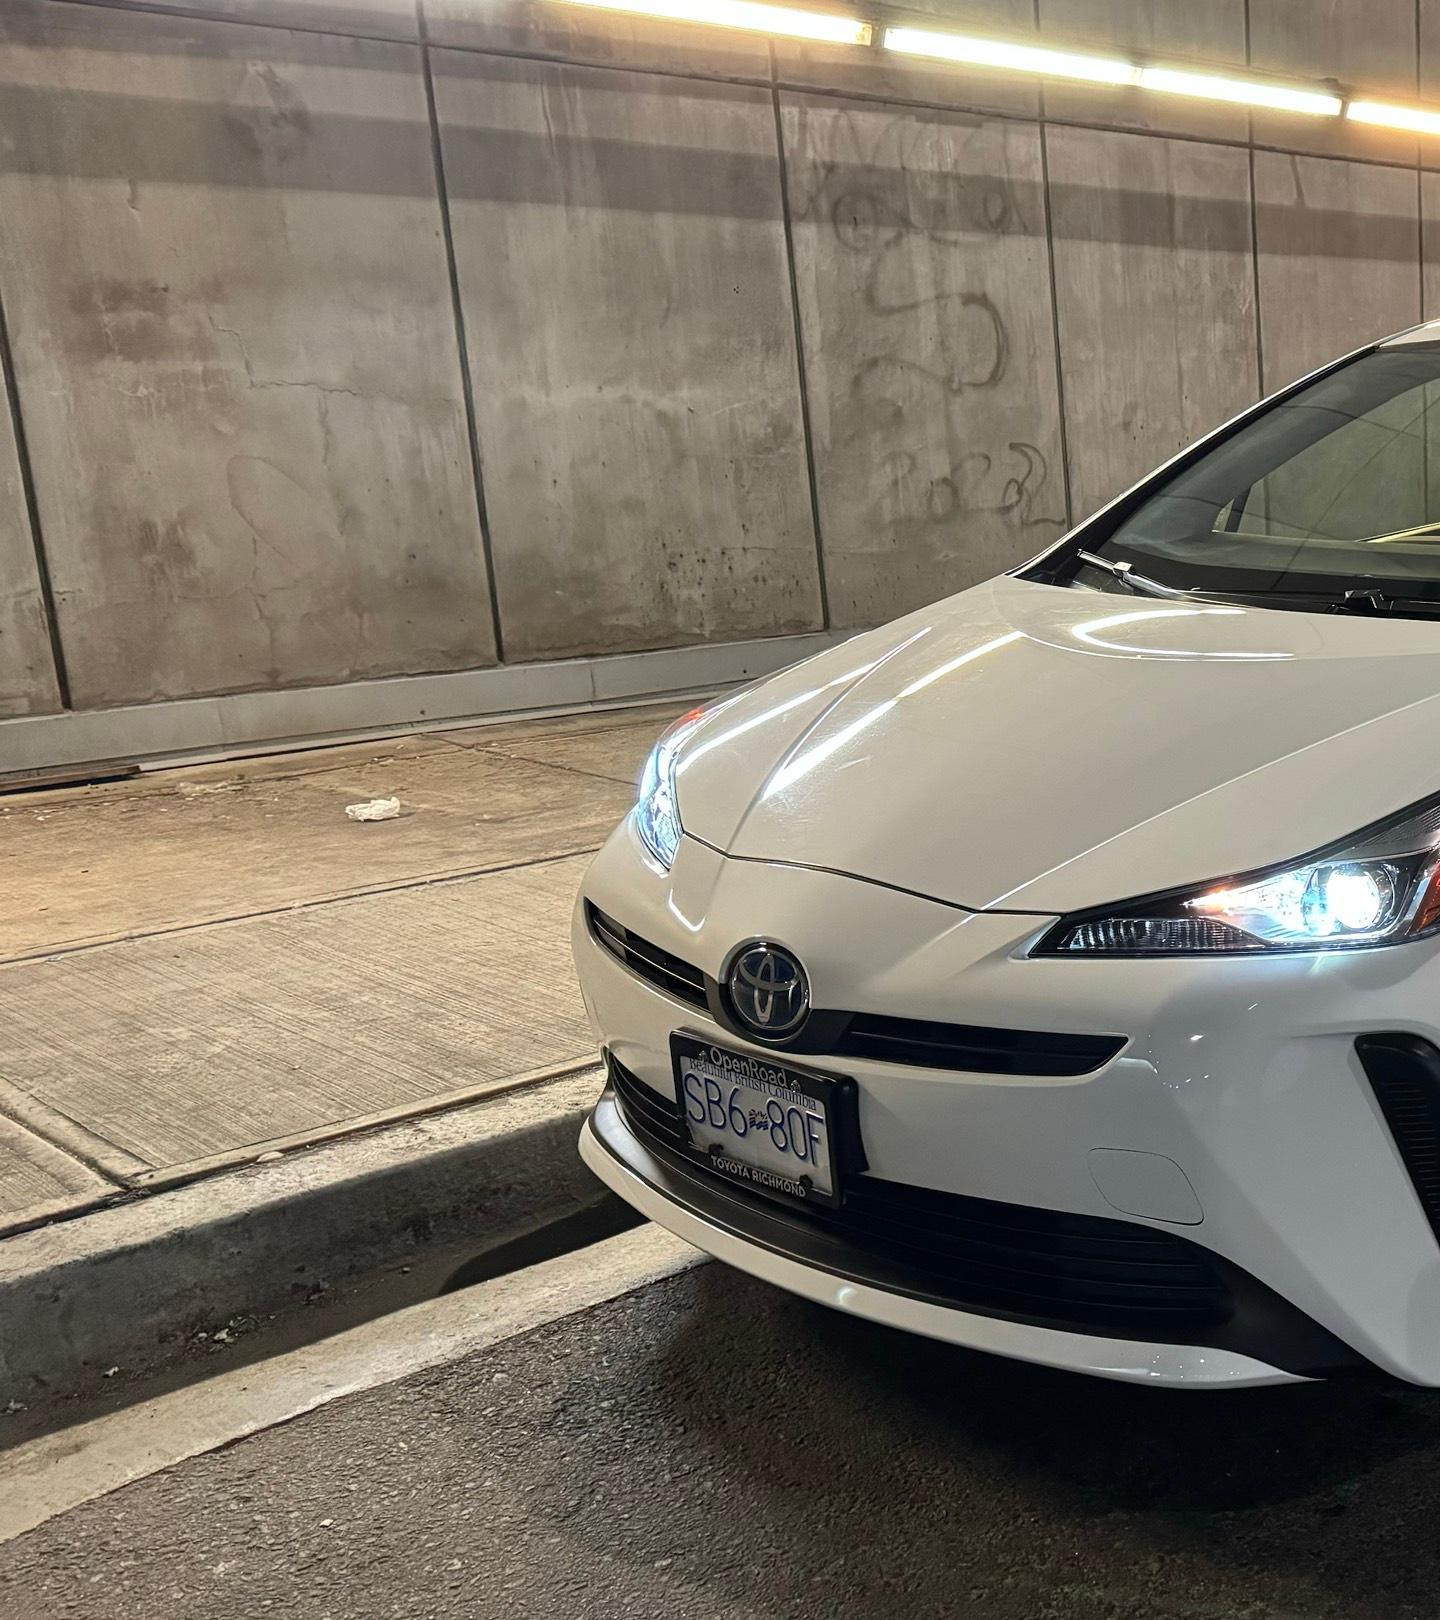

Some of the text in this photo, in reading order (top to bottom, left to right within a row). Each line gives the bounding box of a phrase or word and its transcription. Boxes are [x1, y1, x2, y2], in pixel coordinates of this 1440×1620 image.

[710, 1047, 787, 1088] OpenRoad
[684, 1073, 824, 1166] SB6 80F
[711, 1155, 807, 1197] TOYOTA RICHMOND
